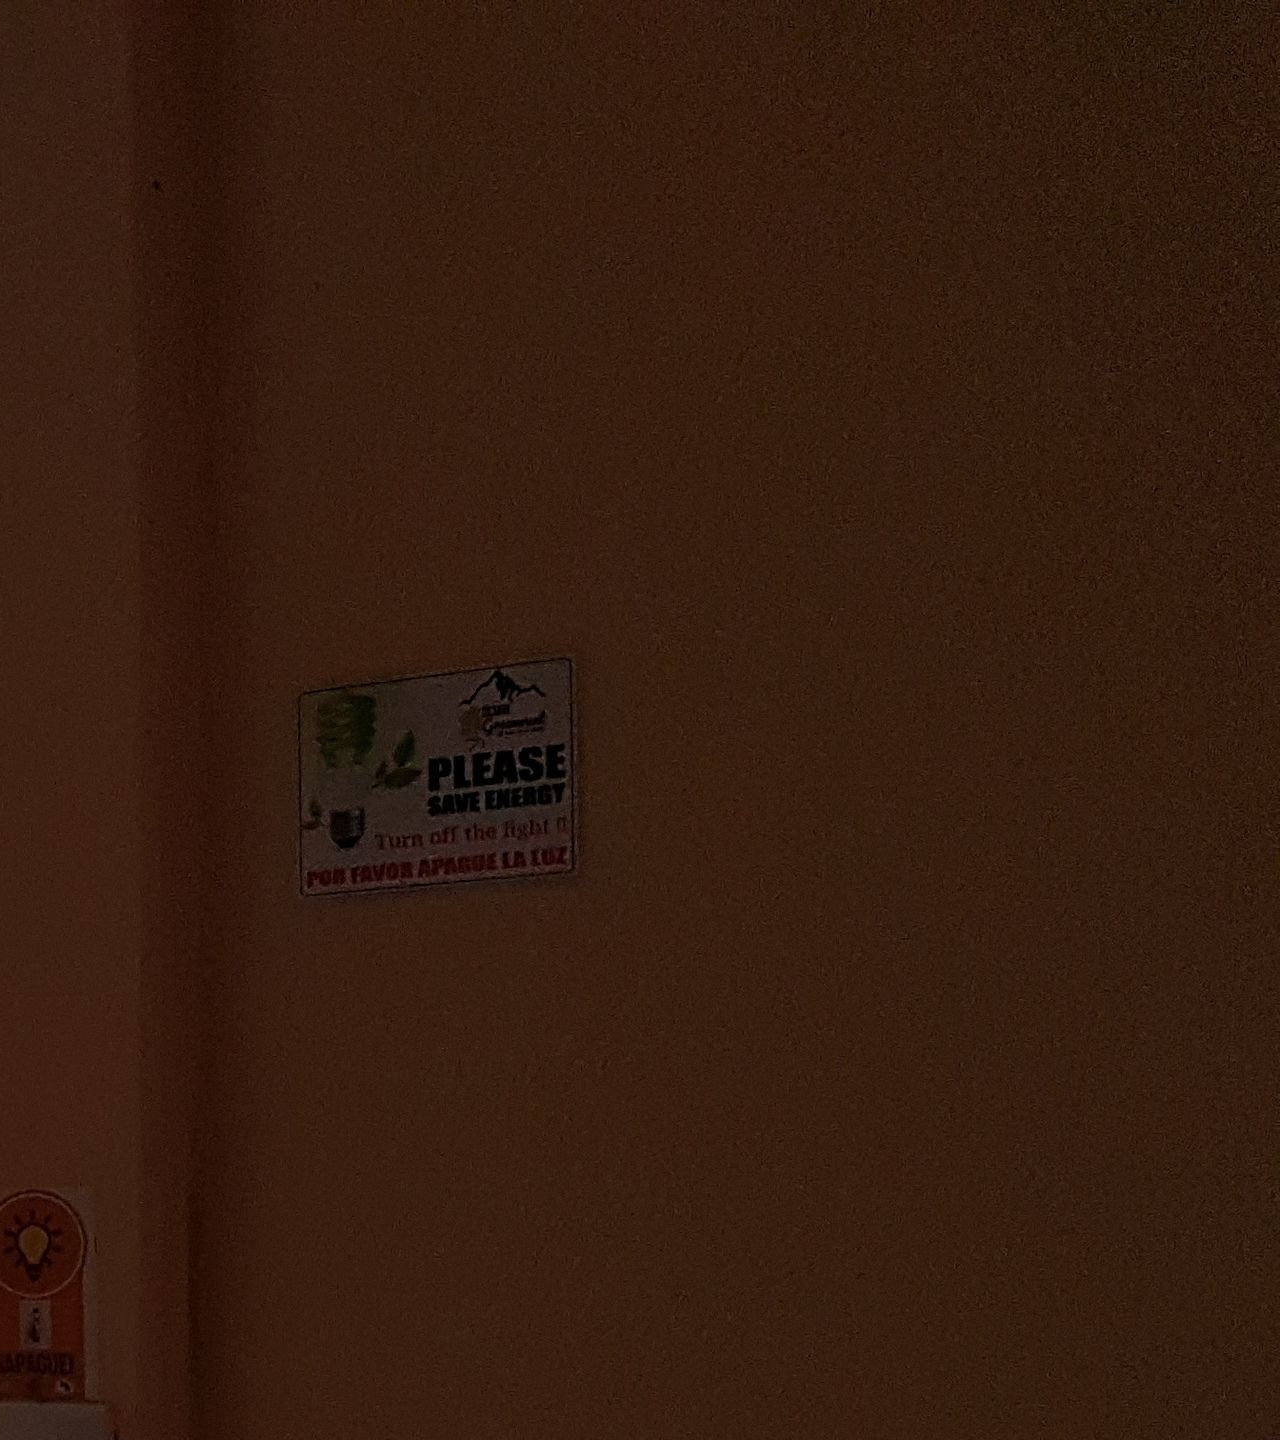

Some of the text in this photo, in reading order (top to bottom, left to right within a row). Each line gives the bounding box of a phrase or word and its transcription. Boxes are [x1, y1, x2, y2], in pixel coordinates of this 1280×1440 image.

[428, 744, 566, 791] PLEASE
[428, 782, 565, 816] SAVE ENERGY
[375, 833, 423, 849] Turn
[430, 823, 456, 844] off
[466, 823, 496, 840] the
[504, 818, 548, 839] light
[307, 846, 567, 888] POR FAVOR APAGUE LA LUZ
